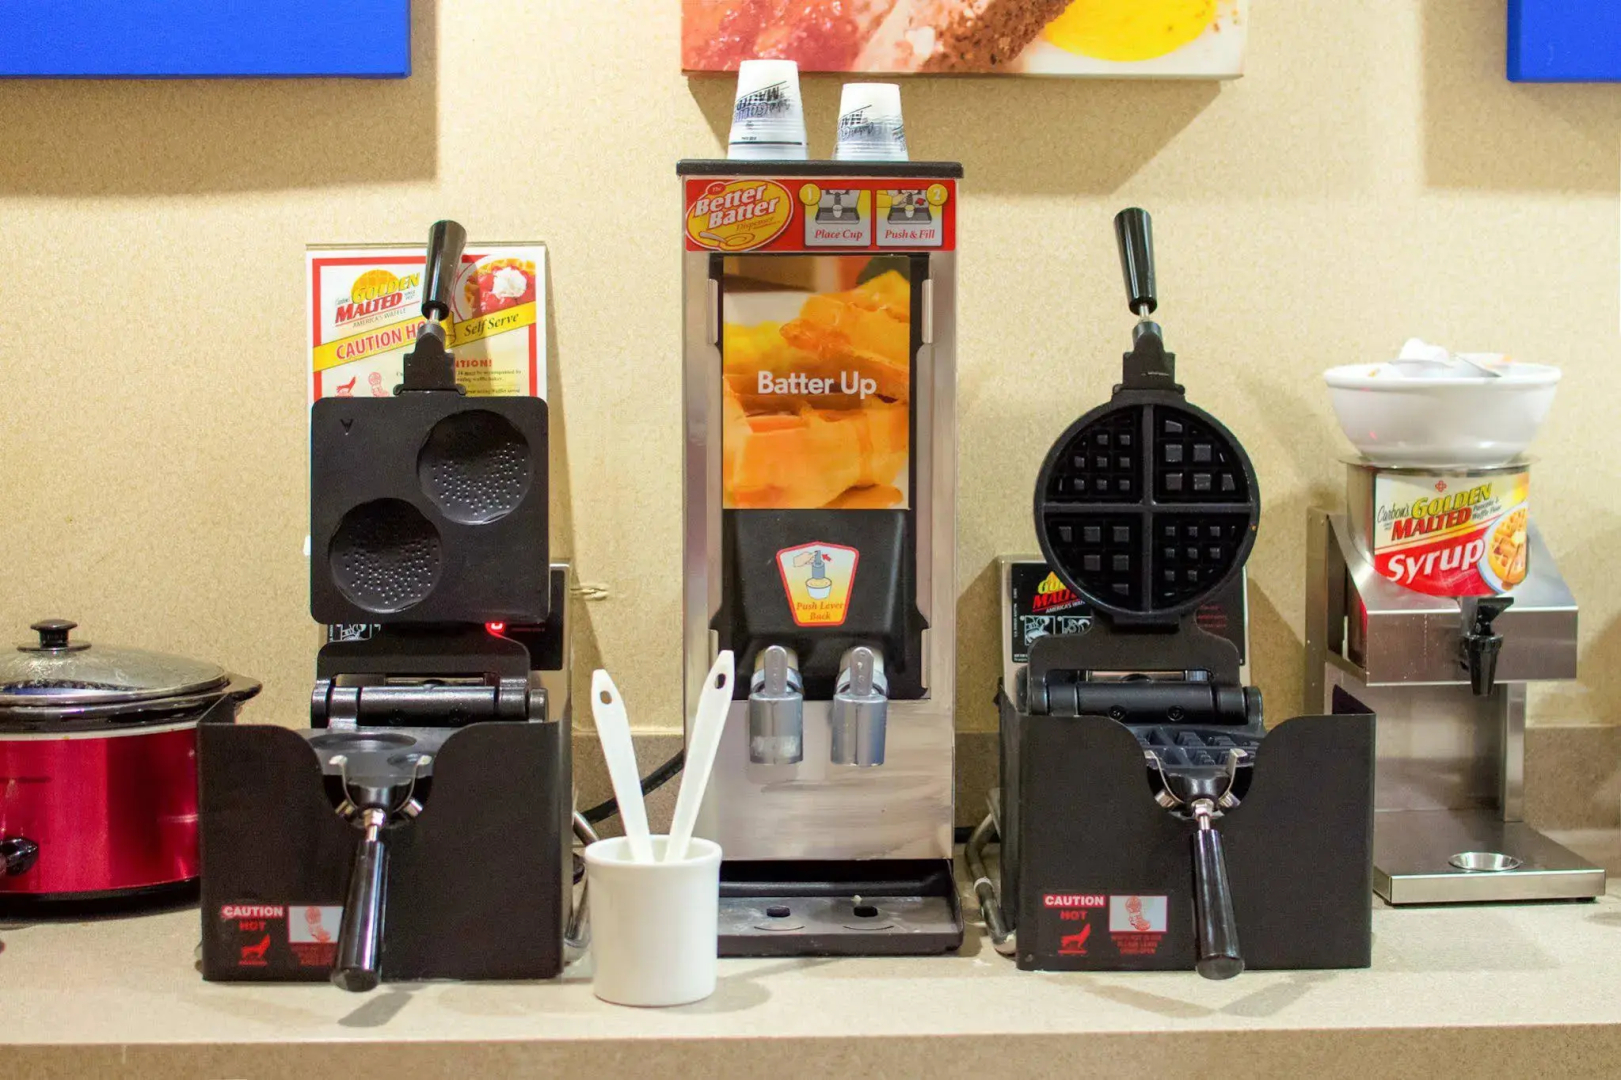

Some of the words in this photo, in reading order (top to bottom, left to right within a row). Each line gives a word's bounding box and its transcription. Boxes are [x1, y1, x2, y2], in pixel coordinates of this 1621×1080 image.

[694, 185, 767, 217] Better
[806, 189, 814, 201] 1
[933, 189, 942, 200] 2
[708, 198, 779, 230] Batter
[814, 229, 841, 240] Place
[843, 229, 863, 242] Cup
[885, 229, 908, 240] Push
[909, 230, 918, 239] &
[918, 229, 935, 240] Fill
[352, 272, 421, 304] GOLDEN
[335, 292, 403, 323] MALTED
[464, 317, 486, 338] Self
[487, 312, 520, 331] Serve
[336, 328, 403, 361] CAUTION
[757, 370, 834, 395] Batter
[840, 371, 877, 400] Up
[1411, 483, 1492, 519] GOLDEN
[1391, 507, 1472, 541] MALTED
[1386, 538, 1485, 584] Syrup
[796, 602, 818, 612] Push
[820, 601, 844, 611] Lever
[810, 611, 831, 622] Back
[1044, 896, 1104, 906] CAUTION
[222, 906, 283, 917] CAUTION
[1060, 911, 1088, 920] HOT
[239, 921, 266, 931] HOT
